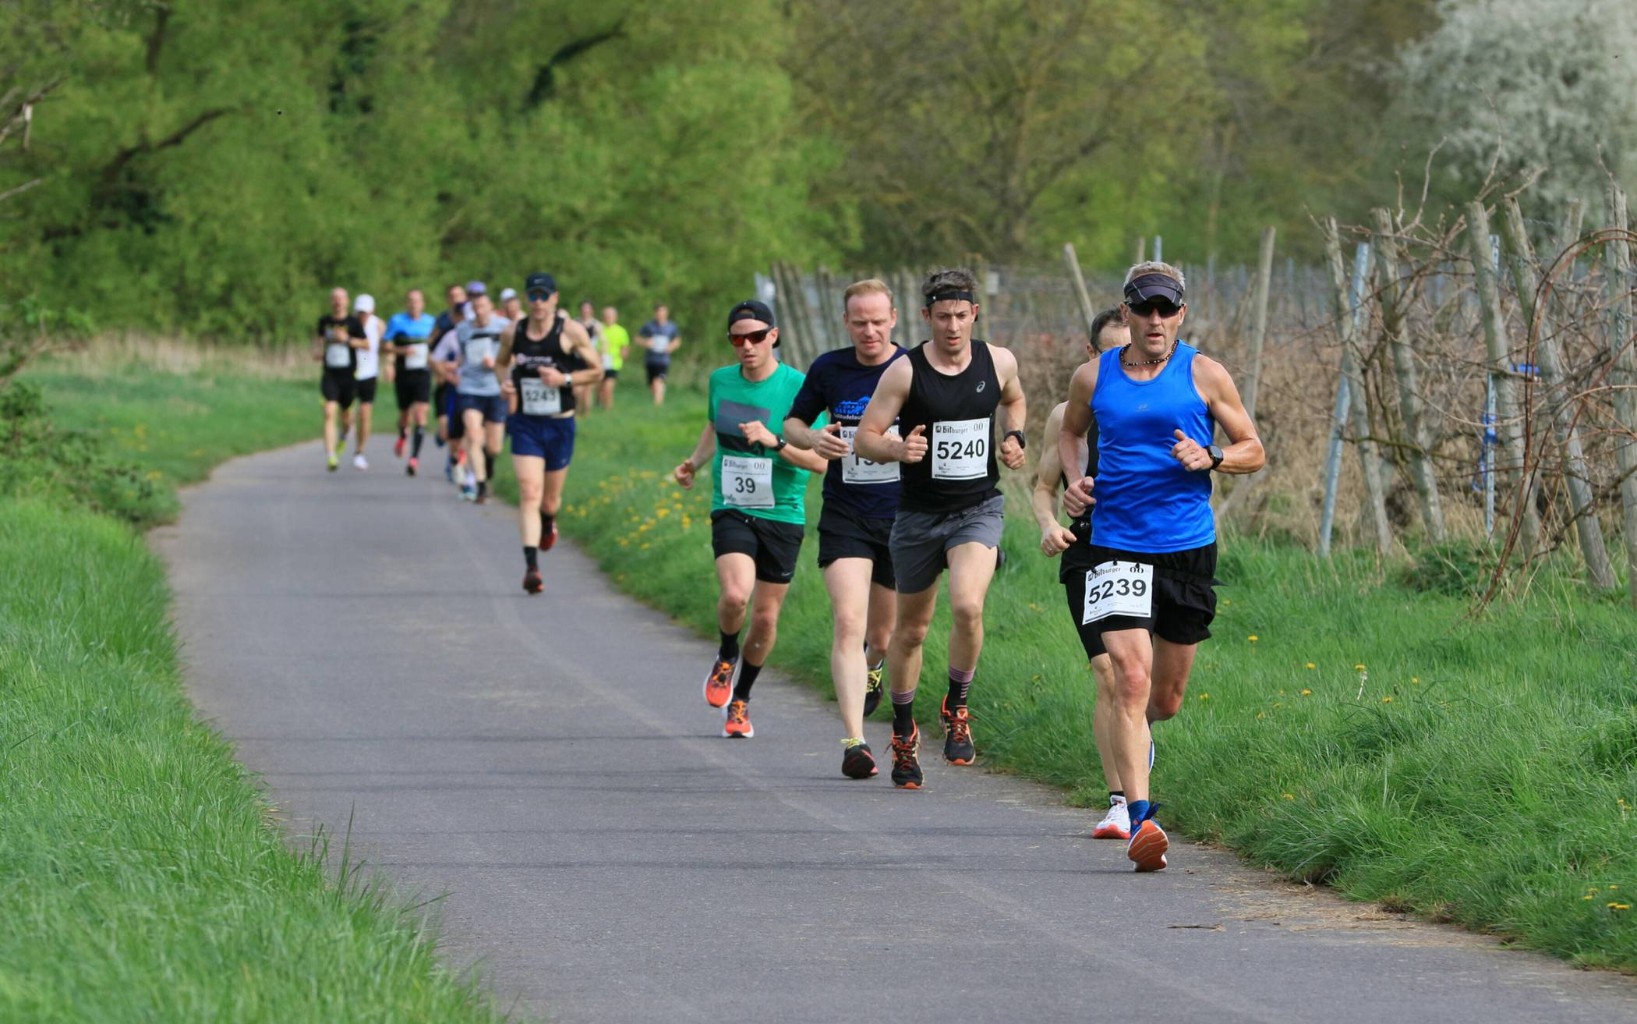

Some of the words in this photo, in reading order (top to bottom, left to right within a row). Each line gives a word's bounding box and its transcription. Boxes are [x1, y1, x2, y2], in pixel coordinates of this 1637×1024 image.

[937, 438, 985, 460] 5240
[735, 476, 756, 494] 39
[1088, 578, 1147, 605] 5239
